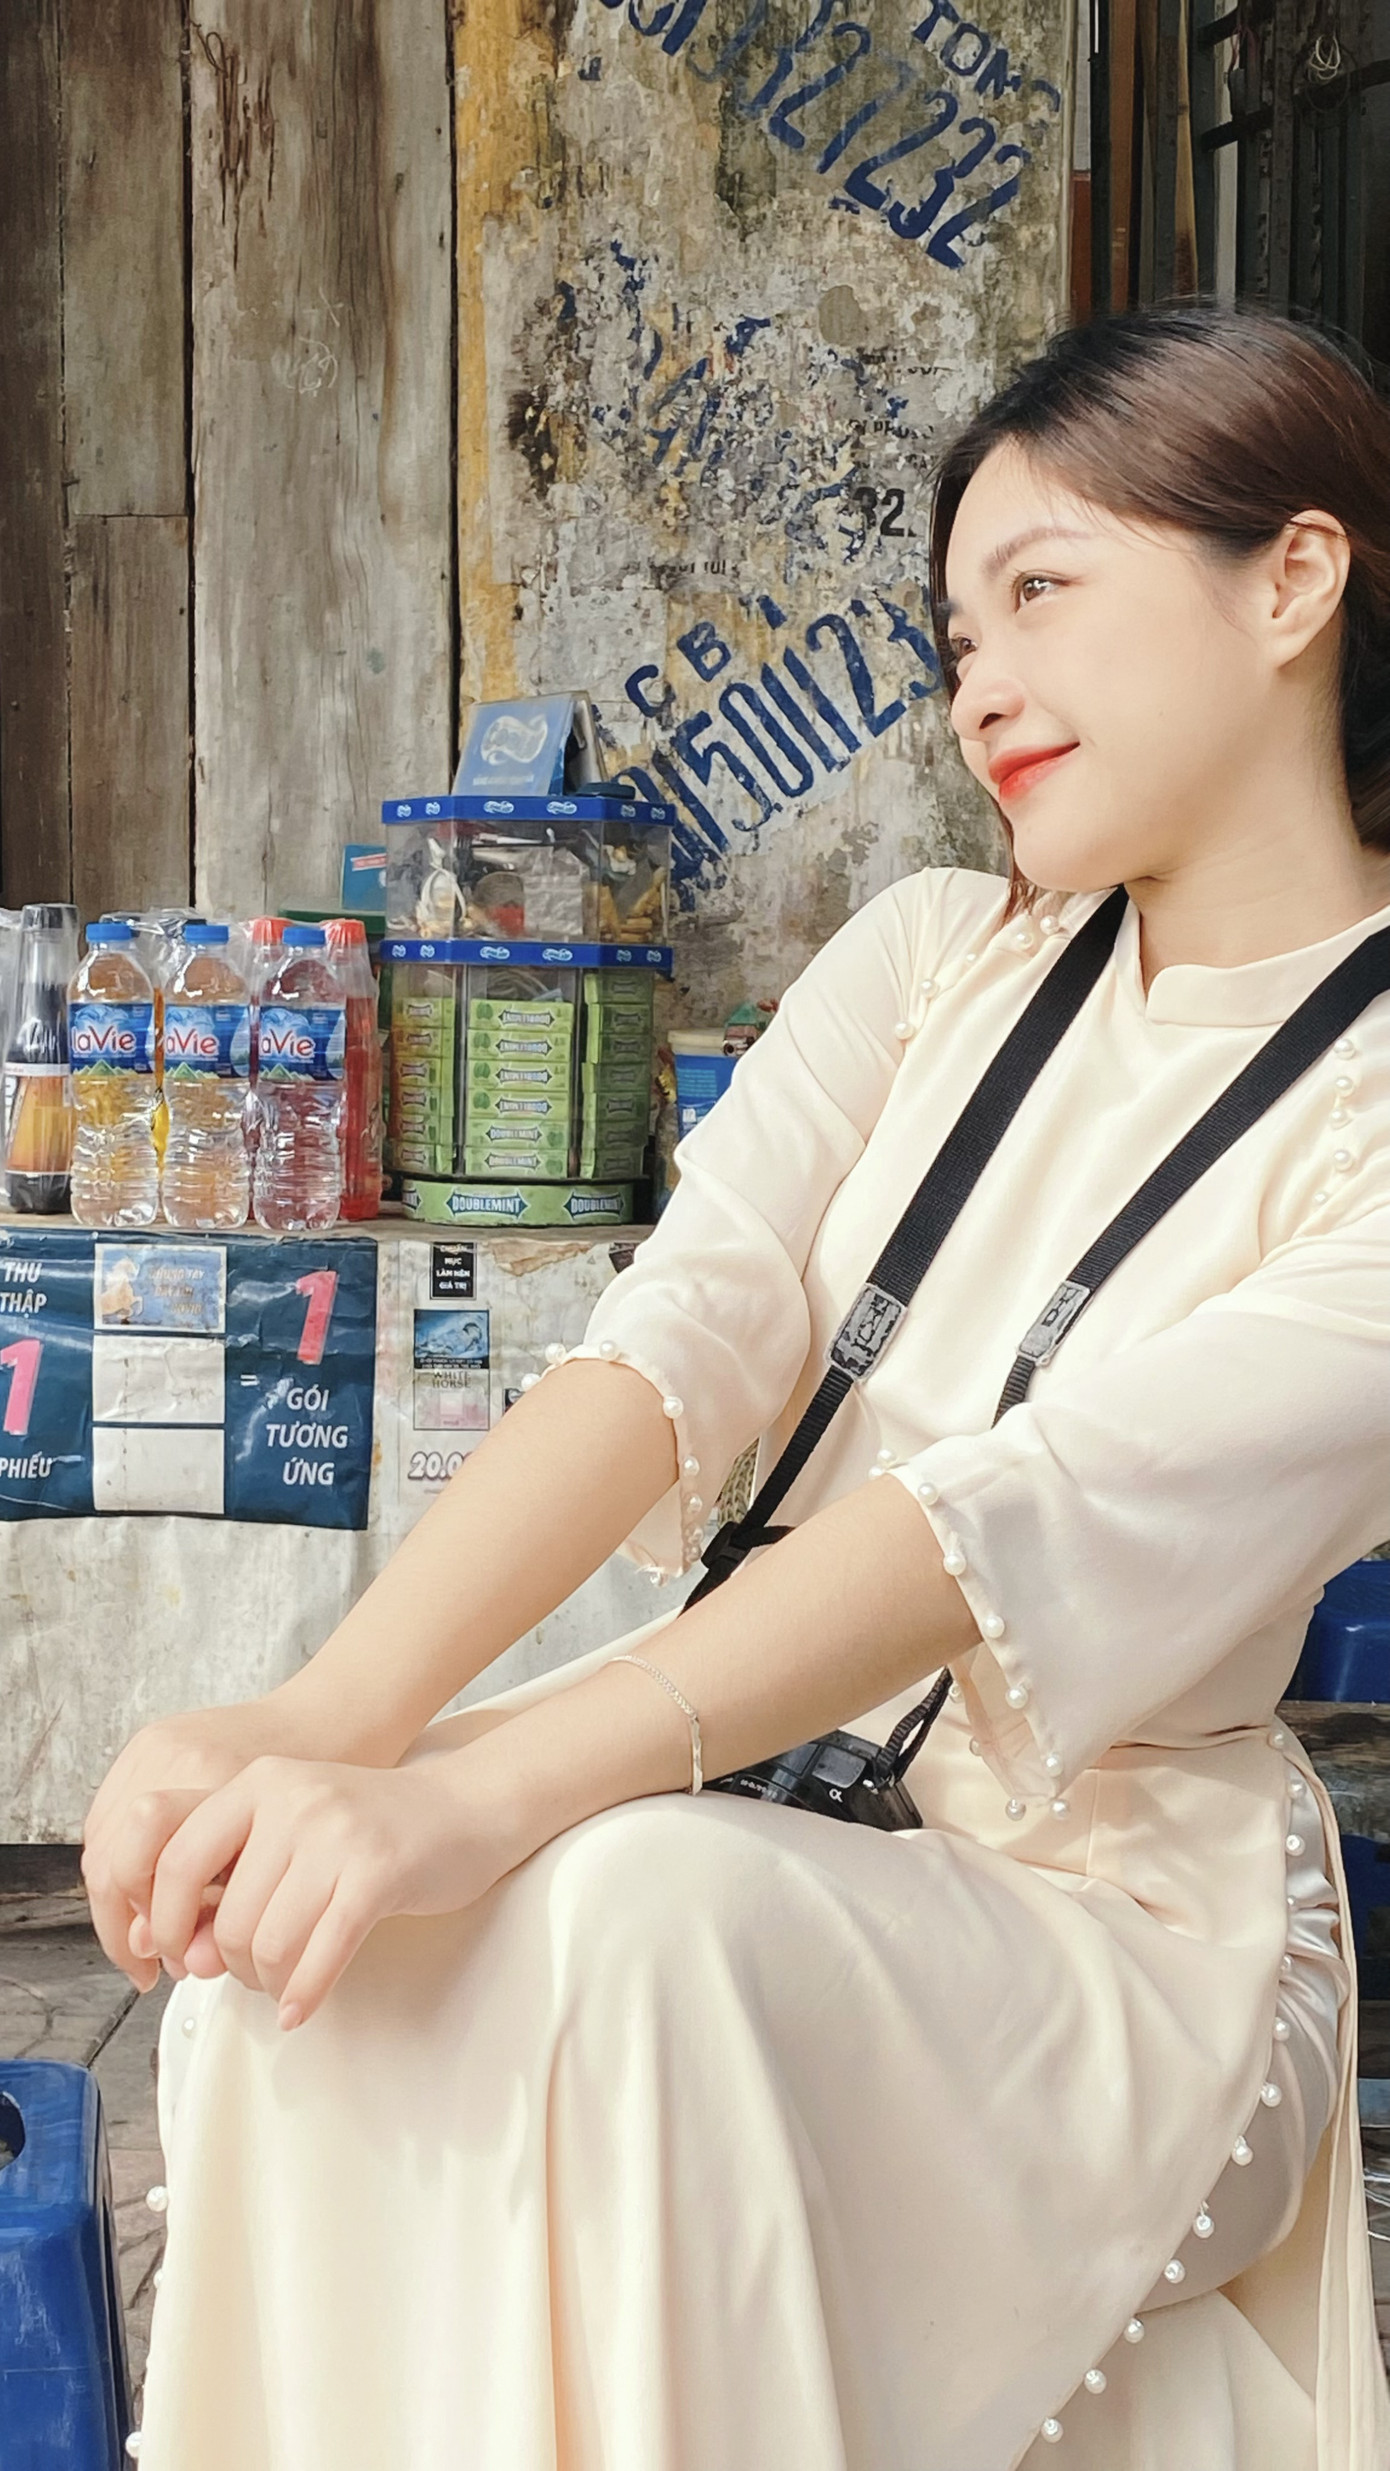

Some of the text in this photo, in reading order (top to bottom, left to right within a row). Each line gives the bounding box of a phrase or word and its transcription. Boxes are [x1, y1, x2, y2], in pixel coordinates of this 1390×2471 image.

[676, 621, 732, 682] B
[71, 1024, 136, 1053] laVie
[166, 1027, 220, 1056] aVie
[261, 1028, 316, 1059] aVie
[452, 1195, 621, 1213] DOUBLEMINT DOUBLEMINT
[4, 1262, 42, 1283] THU
[0, 1288, 48, 1318] THẬP
[296, 1270, 339, 1365] 1
[0, 1338, 44, 1436] 1
[432, 1379, 472, 1389] HORSE
[433, 1371, 472, 1380] WHITE
[286, 1384, 329, 1412] GÓI
[266, 1420, 348, 1449] TƯƠNG
[0, 1451, 51, 1479] PHIẾU
[283, 1457, 335, 1486] ỨNG
[408, 1451, 472, 1480] 20.0
